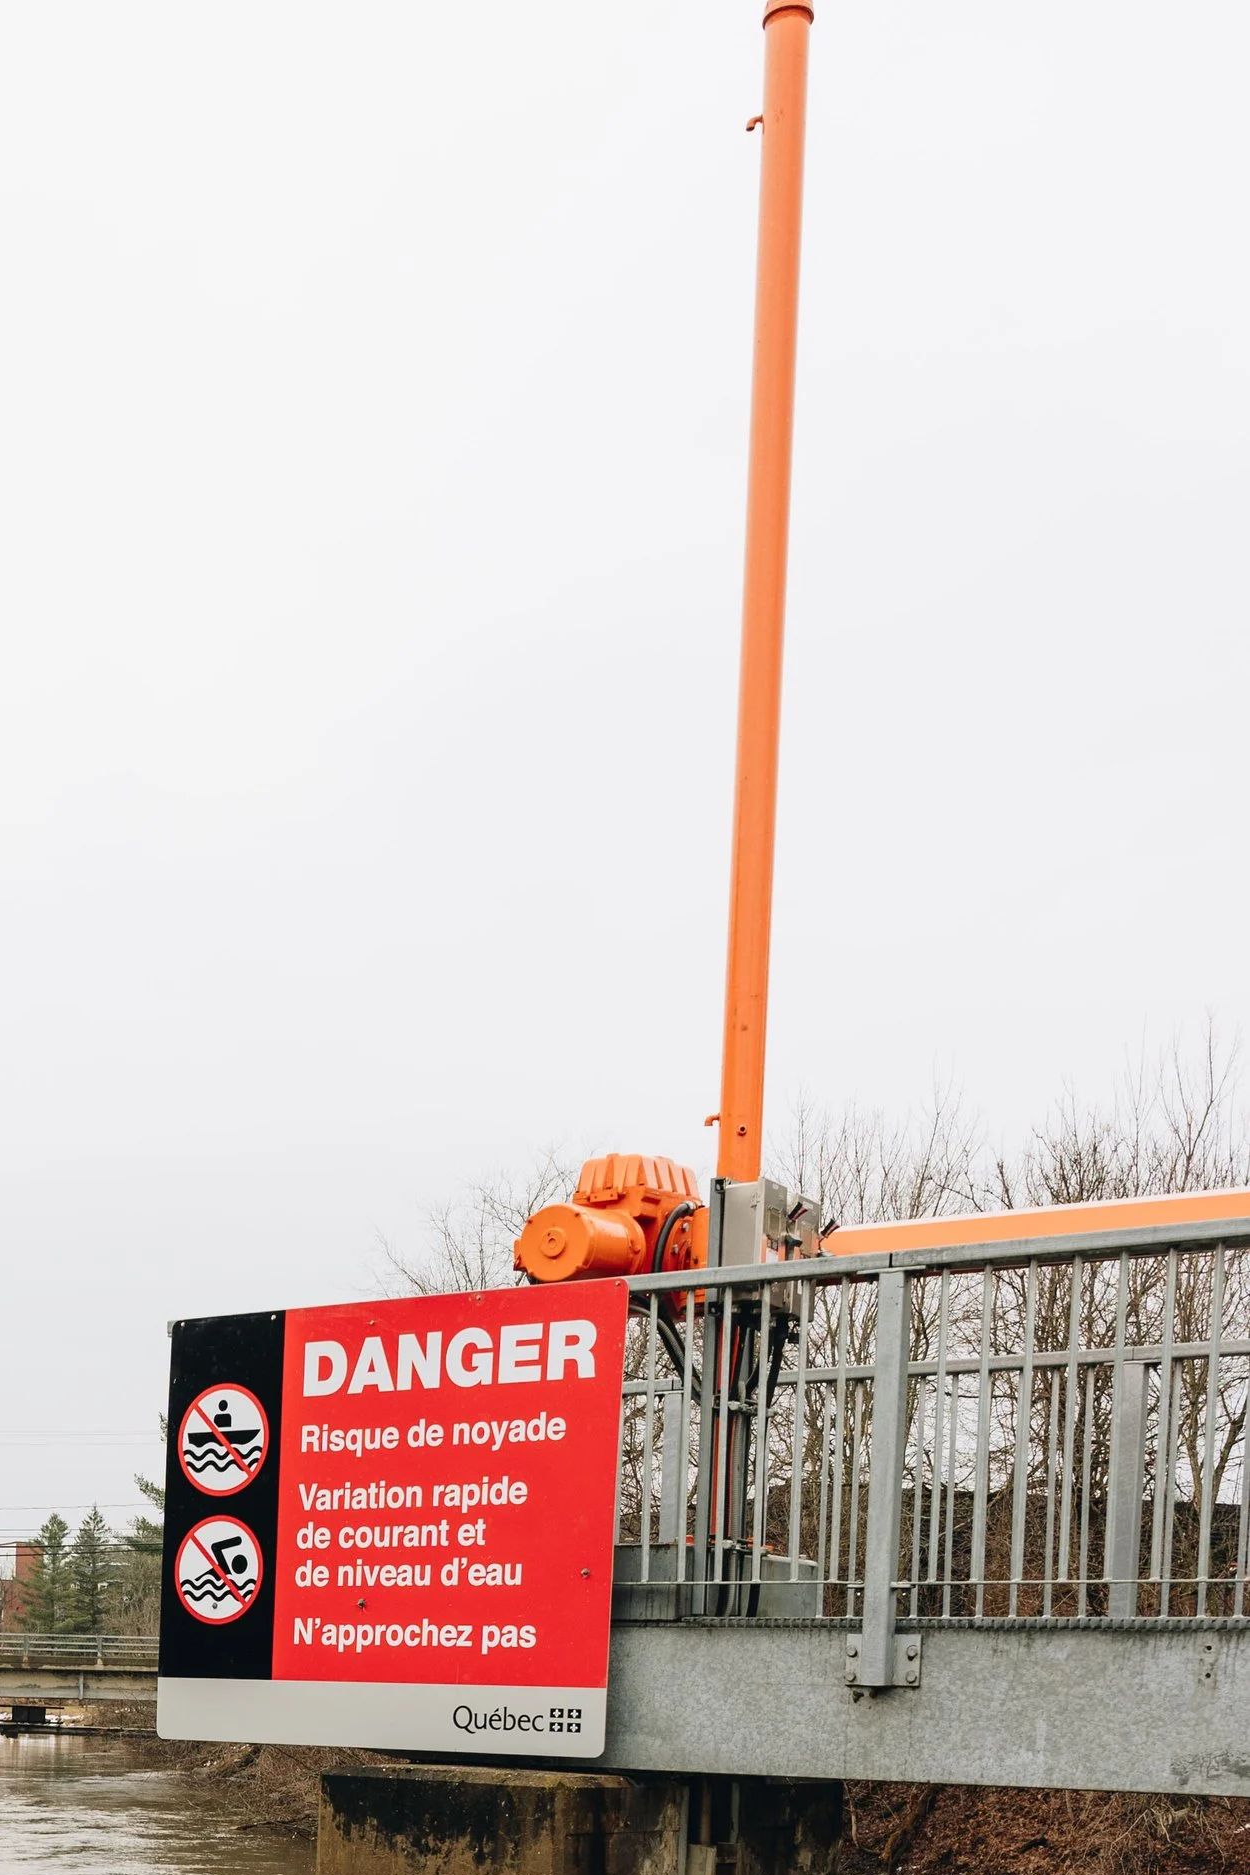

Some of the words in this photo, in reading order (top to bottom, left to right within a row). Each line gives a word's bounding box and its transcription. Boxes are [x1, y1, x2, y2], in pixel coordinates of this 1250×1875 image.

[302, 1319, 597, 1397] DANGER
[301, 1423, 400, 1457] Risque
[407, 1418, 444, 1448] de
[452, 1411, 567, 1451] noyade
[298, 1482, 423, 1511] Variation
[432, 1475, 528, 1514] rapide
[296, 1521, 331, 1550] de
[338, 1520, 450, 1549] courant
[457, 1518, 487, 1547] et
[294, 1559, 330, 1588] de
[337, 1558, 432, 1588] niveau
[440, 1557, 523, 1587] d’eau
[293, 1617, 473, 1654] N’approchez
[481, 1624, 537, 1655] pas
[452, 1705, 545, 1735] Québec
